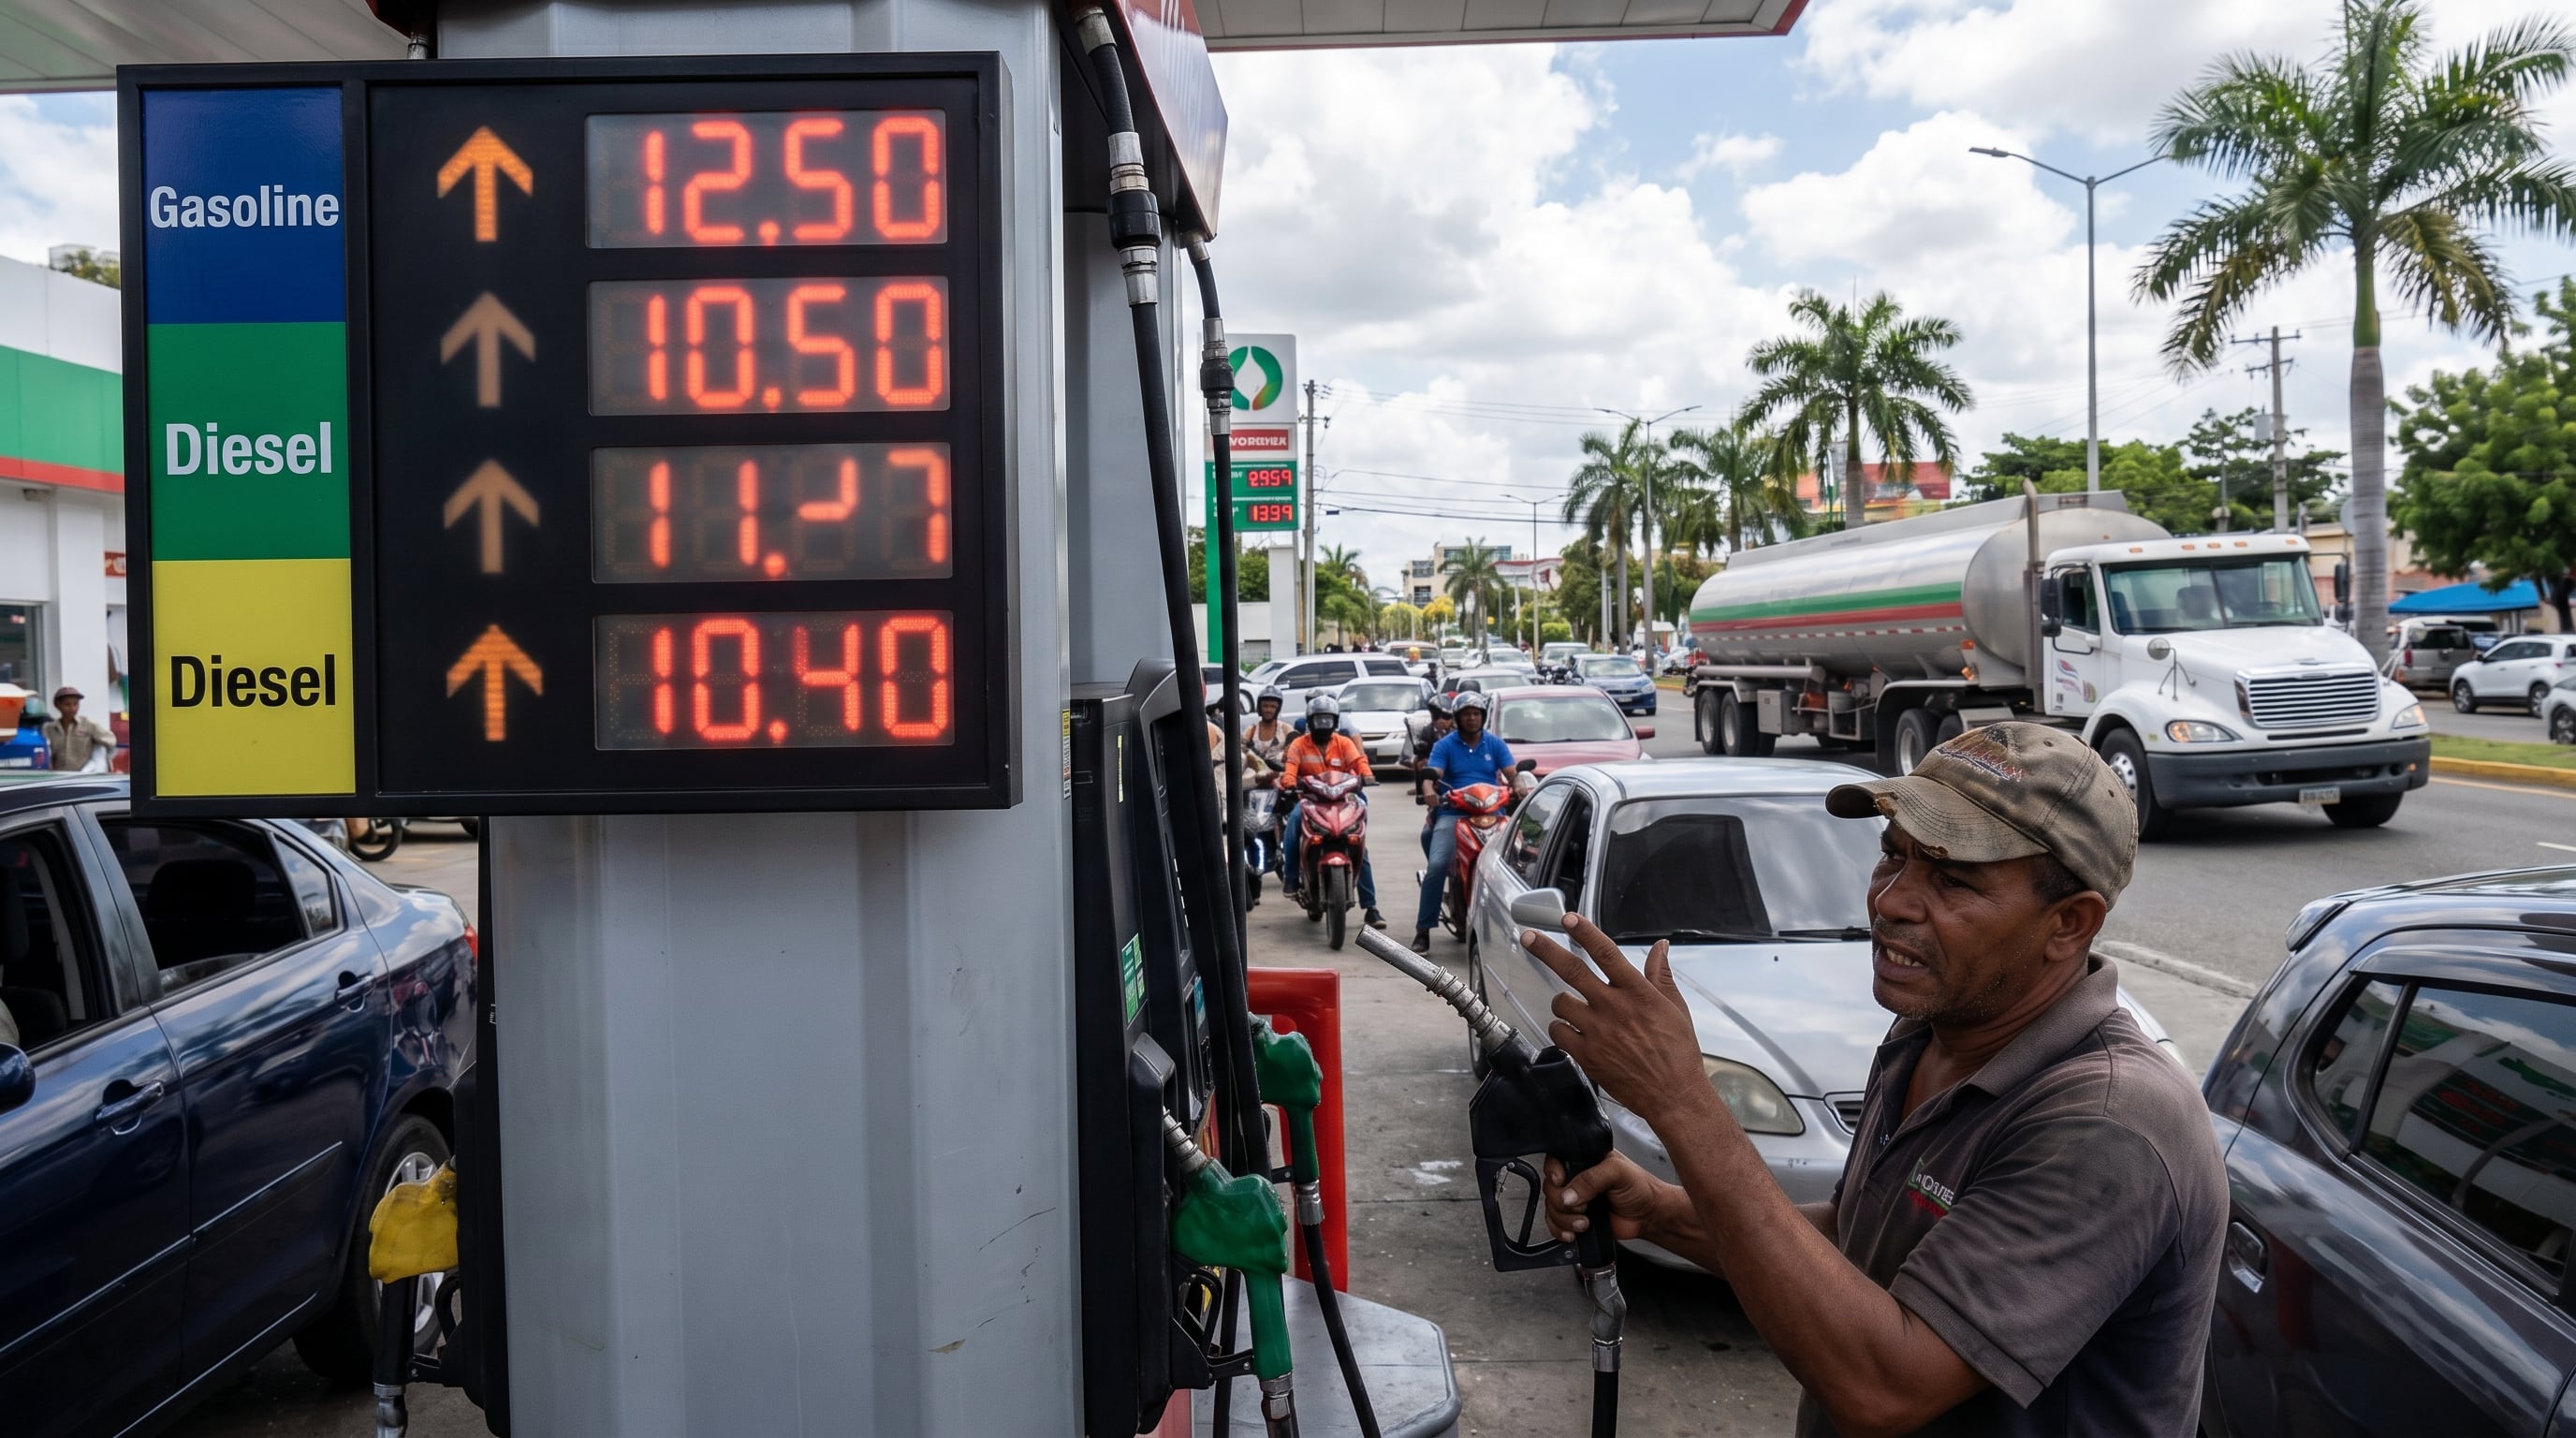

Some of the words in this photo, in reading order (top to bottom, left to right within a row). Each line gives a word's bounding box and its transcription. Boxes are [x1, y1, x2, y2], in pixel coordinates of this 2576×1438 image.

[149, 183, 340, 229] Gasoline
[643, 118, 942, 243] 12.50
[648, 284, 943, 408] 10.50
[165, 421, 334, 476] Diesel
[169, 653, 337, 708] Diesel
[653, 617, 948, 741] 10.40
